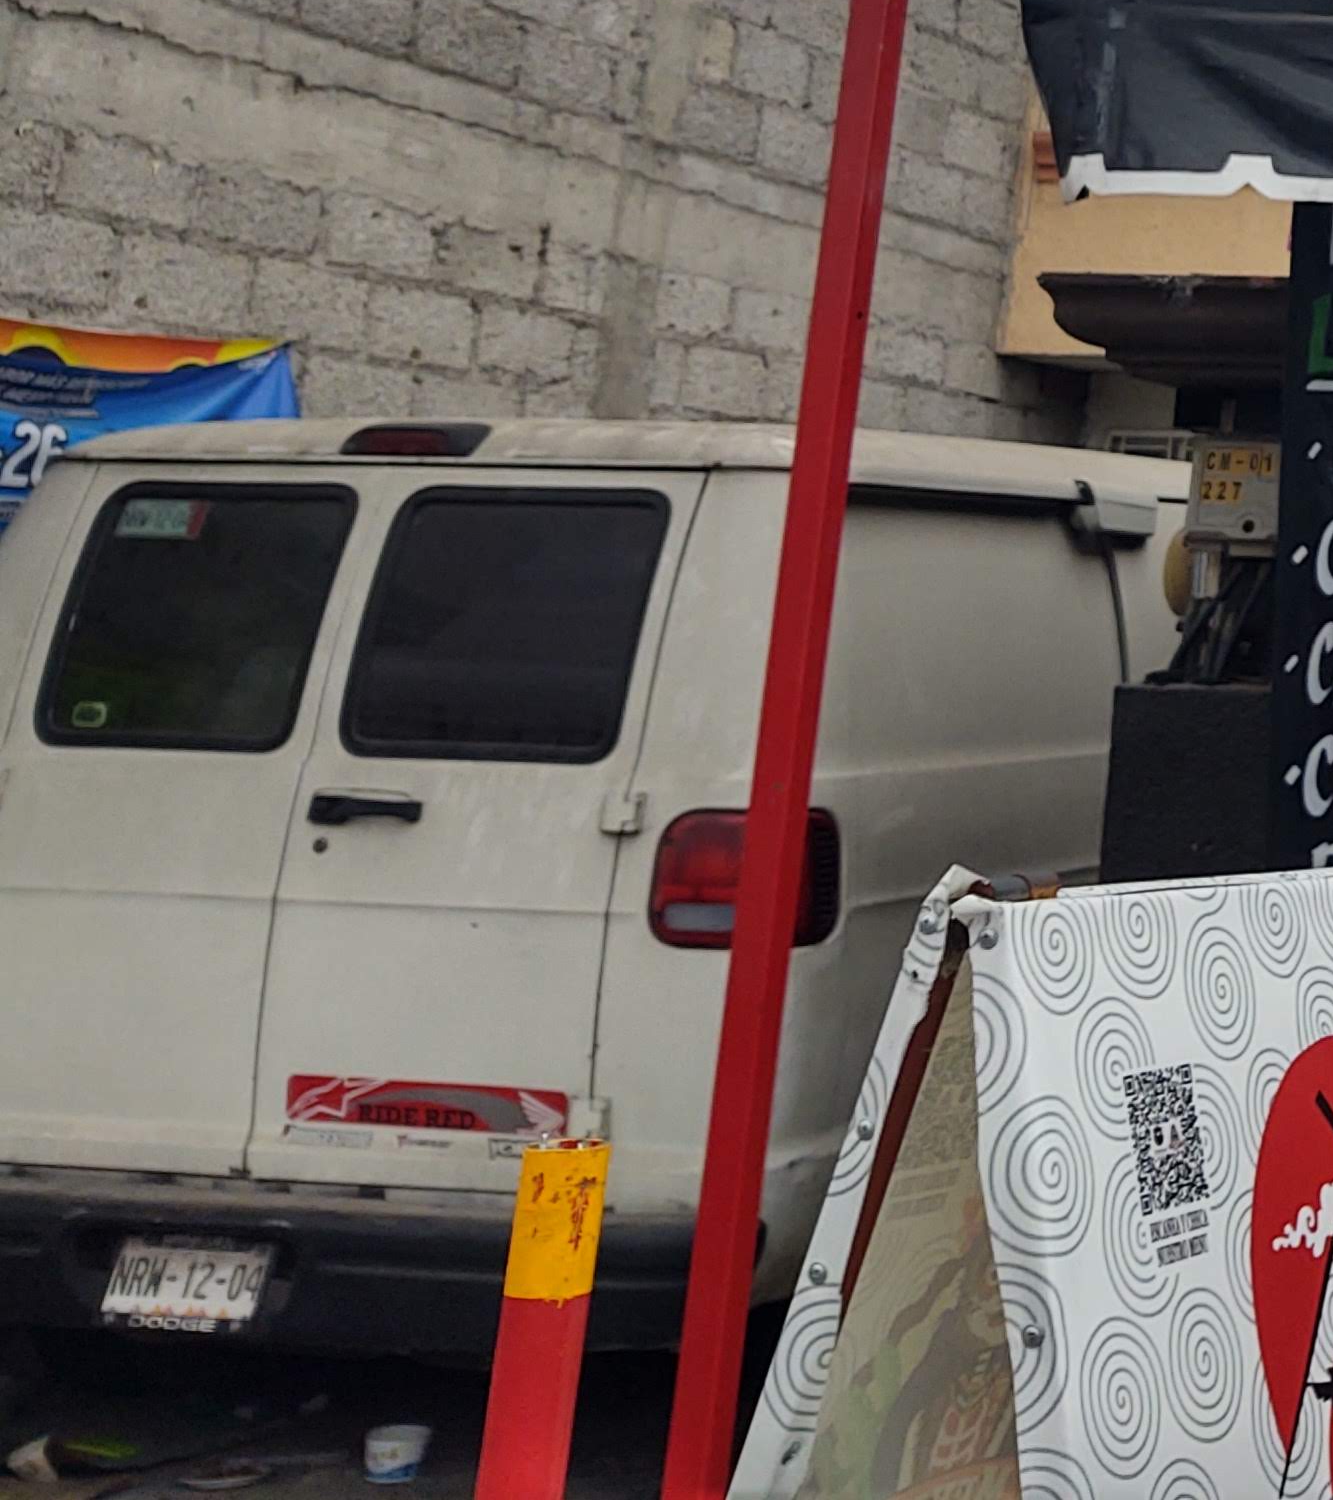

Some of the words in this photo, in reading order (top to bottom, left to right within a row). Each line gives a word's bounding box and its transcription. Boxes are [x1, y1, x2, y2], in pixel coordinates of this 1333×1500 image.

[1202, 481, 1243, 501] 227
[358, 1104, 419, 1125] RIDE
[423, 1108, 477, 1131] RED
[127, 1315, 217, 1333] DODGE
